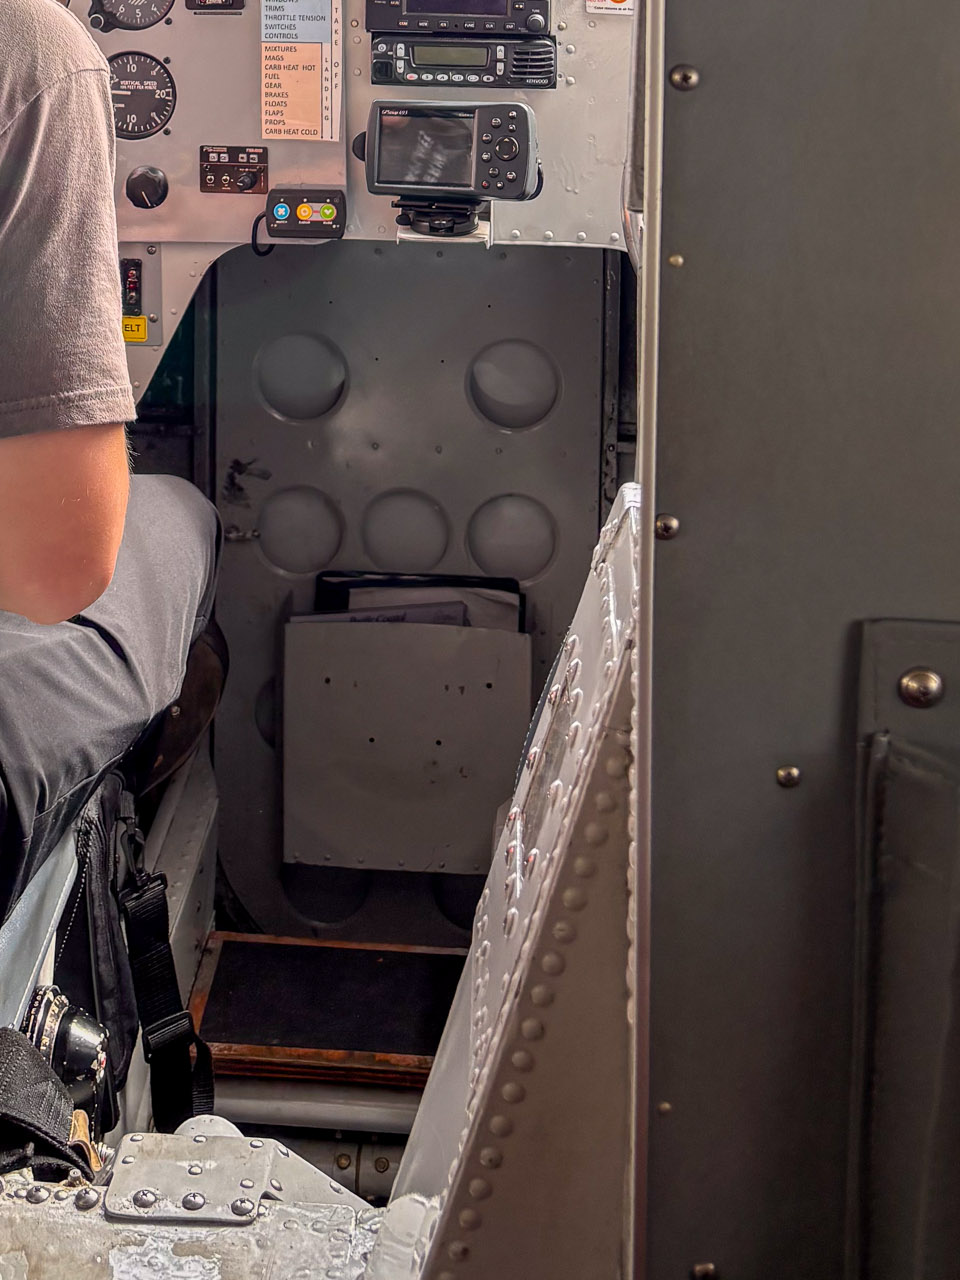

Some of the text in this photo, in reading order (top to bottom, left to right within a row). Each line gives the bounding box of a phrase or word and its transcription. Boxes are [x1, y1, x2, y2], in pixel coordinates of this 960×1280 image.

[119, 4, 125, 13] 6
[151, 3, 157, 11] 4
[136, 9, 141, 17] 5
[127, 64, 137, 73] 10
[155, 90, 166, 98] 20
[127, 114, 137, 123] 10
[125, 324, 141, 332] ELT
